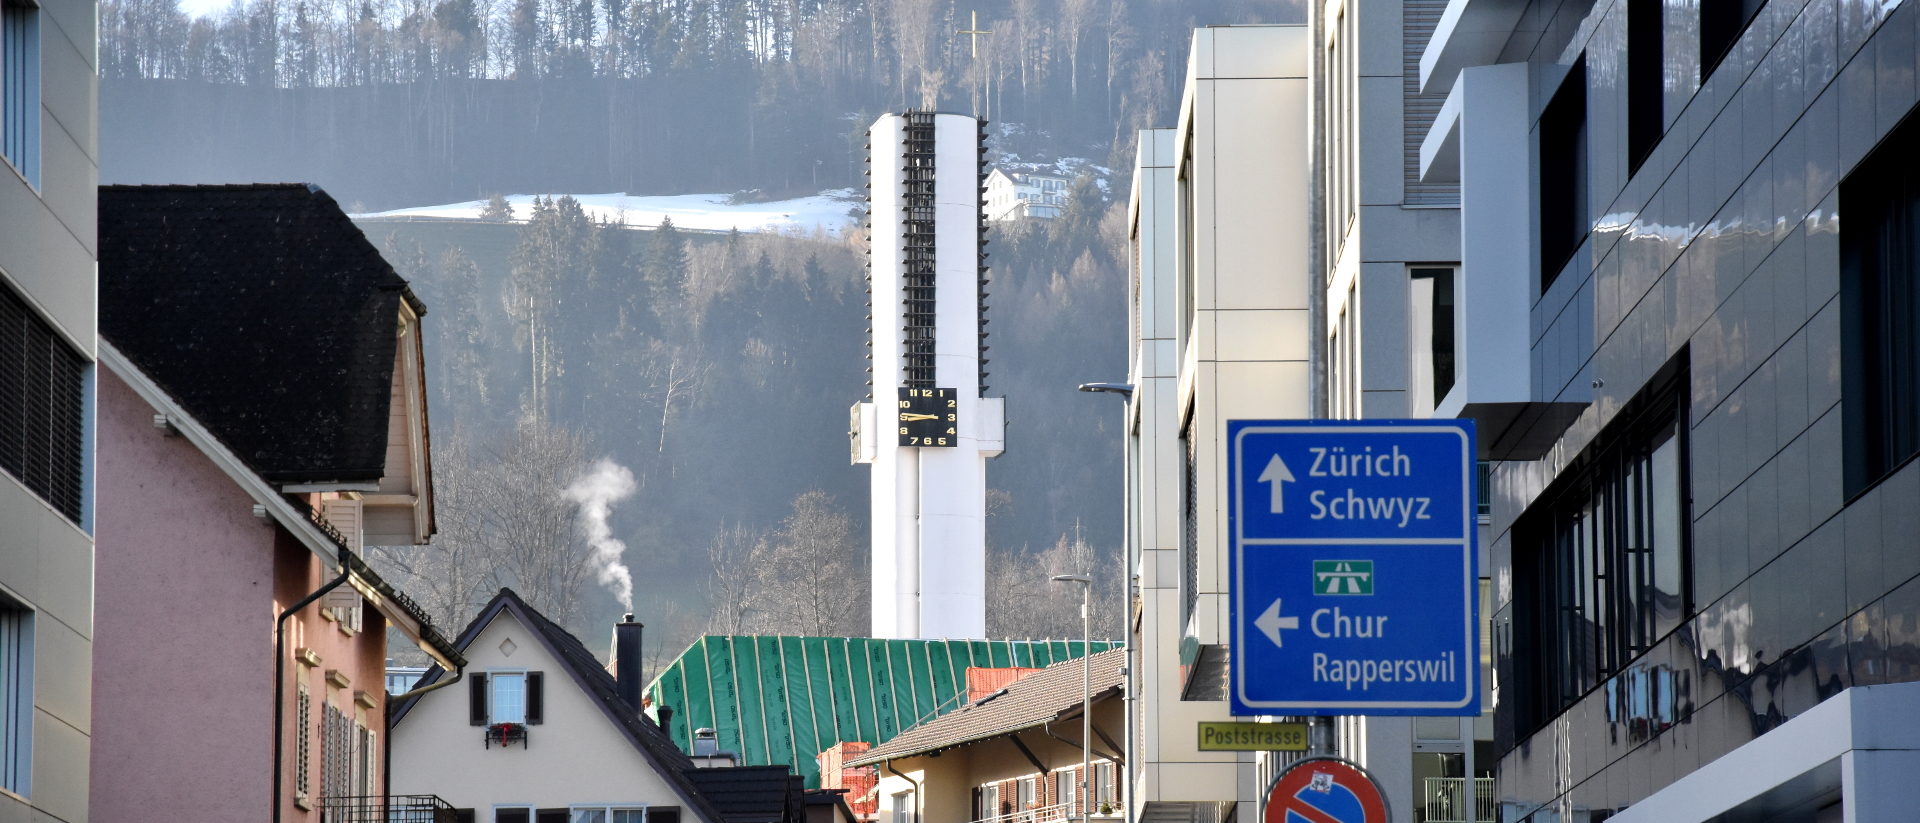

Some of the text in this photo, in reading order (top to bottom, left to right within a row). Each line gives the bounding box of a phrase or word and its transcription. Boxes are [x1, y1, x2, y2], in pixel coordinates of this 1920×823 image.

[1309, 445, 1411, 477] Zürich
[1309, 488, 1431, 528] Schwyz
[1310, 606, 1388, 639] Chur
[1313, 651, 1455, 691] Rapperswil
[1204, 726, 1301, 746] Poststrasse
